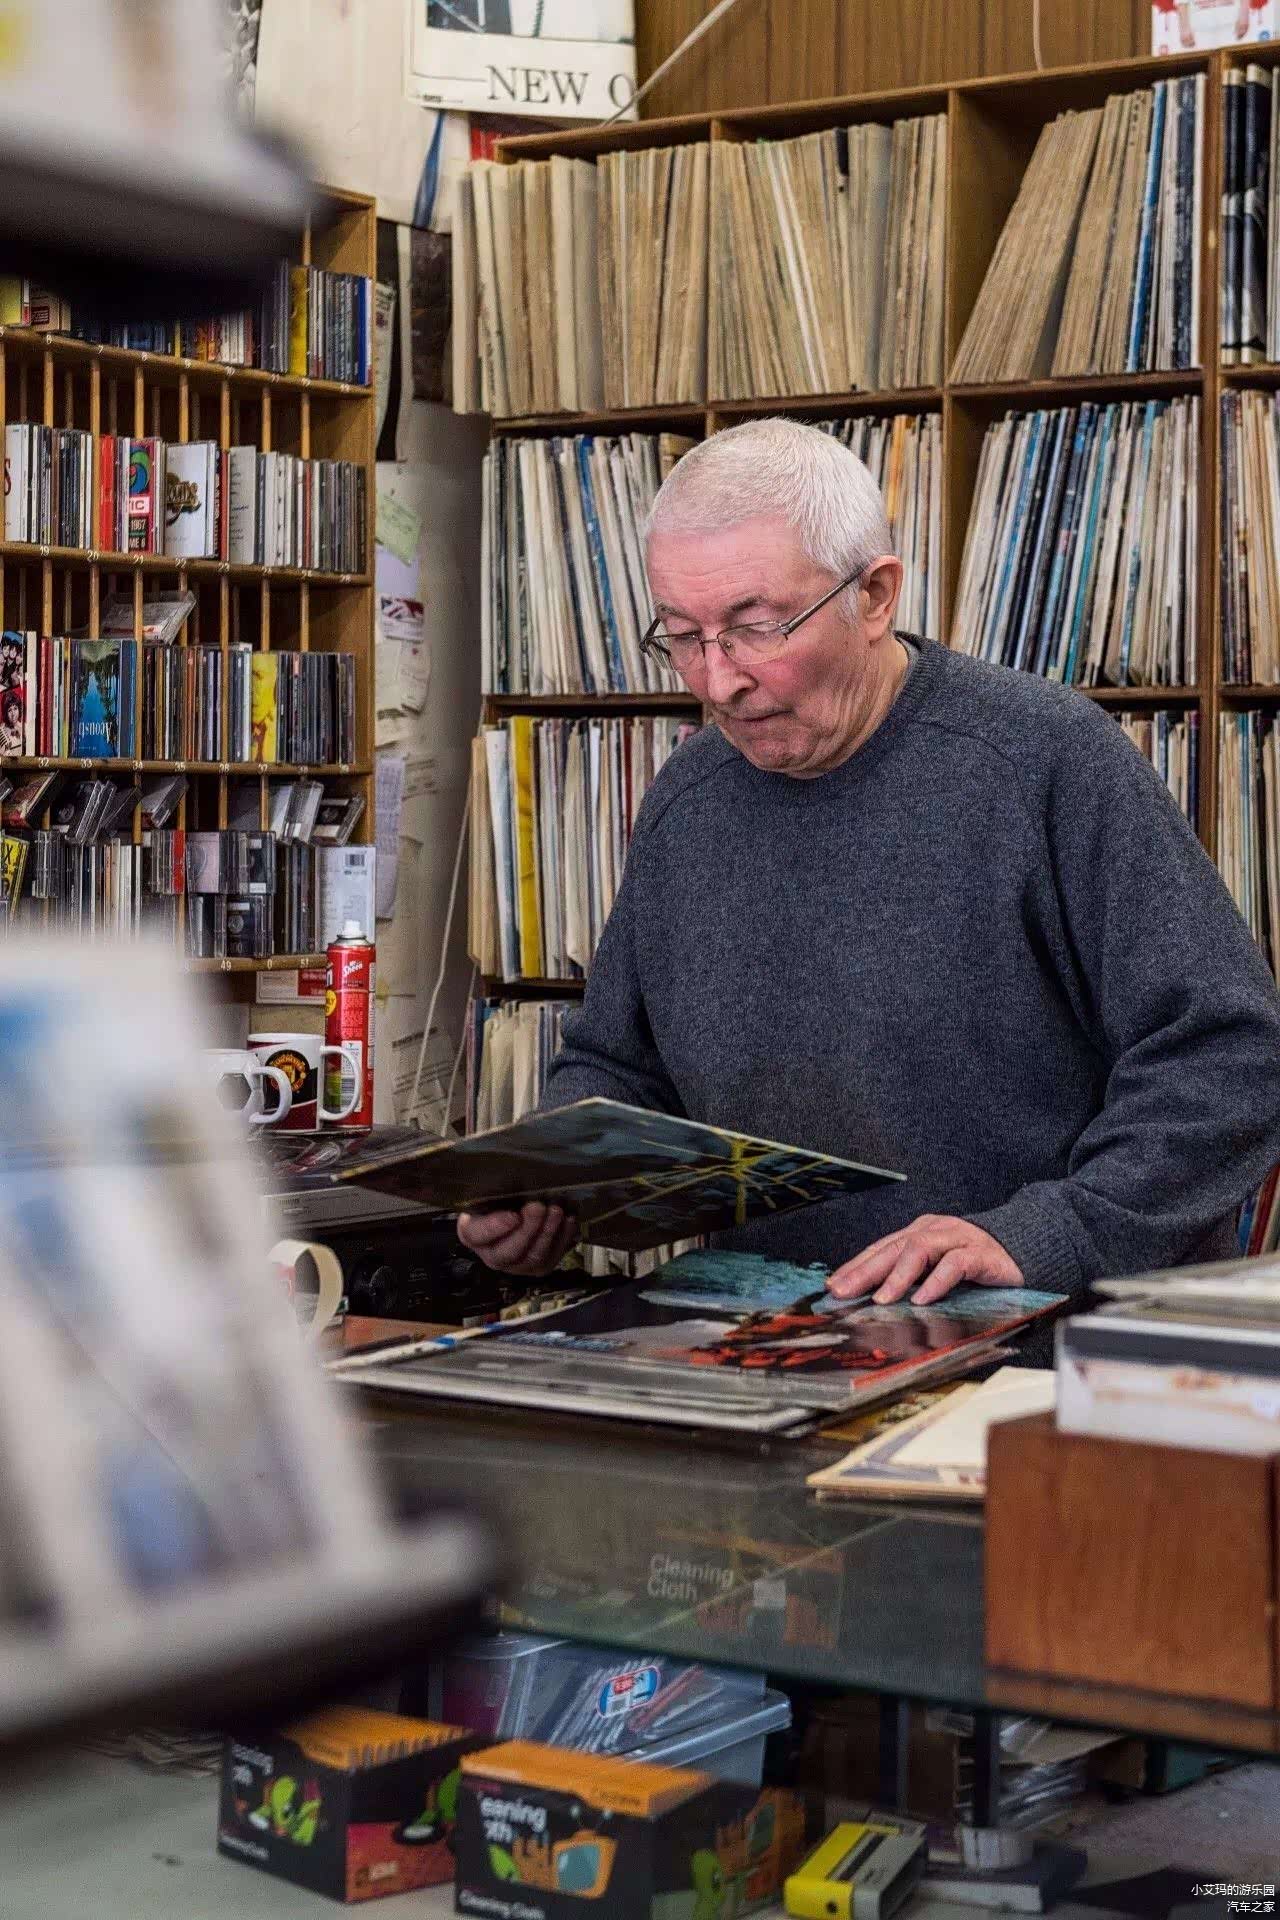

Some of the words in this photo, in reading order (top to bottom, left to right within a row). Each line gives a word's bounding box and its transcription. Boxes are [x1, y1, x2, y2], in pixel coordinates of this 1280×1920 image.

[486, 65, 589, 105] NEW
[40, 546, 50, 557] 19
[87, 550, 99, 562] 20
[133, 554, 144, 565] 21
[175, 558, 187, 569] 22
[38, 757, 50, 768] 32
[80, 757, 93, 768] 33
[132, 760, 143, 771] 34
[174, 761, 186, 772] 35
[220, 960, 232, 971] 49
[649, 1553, 734, 1590] Cleaning
[647, 1575, 698, 1603] Cloth
